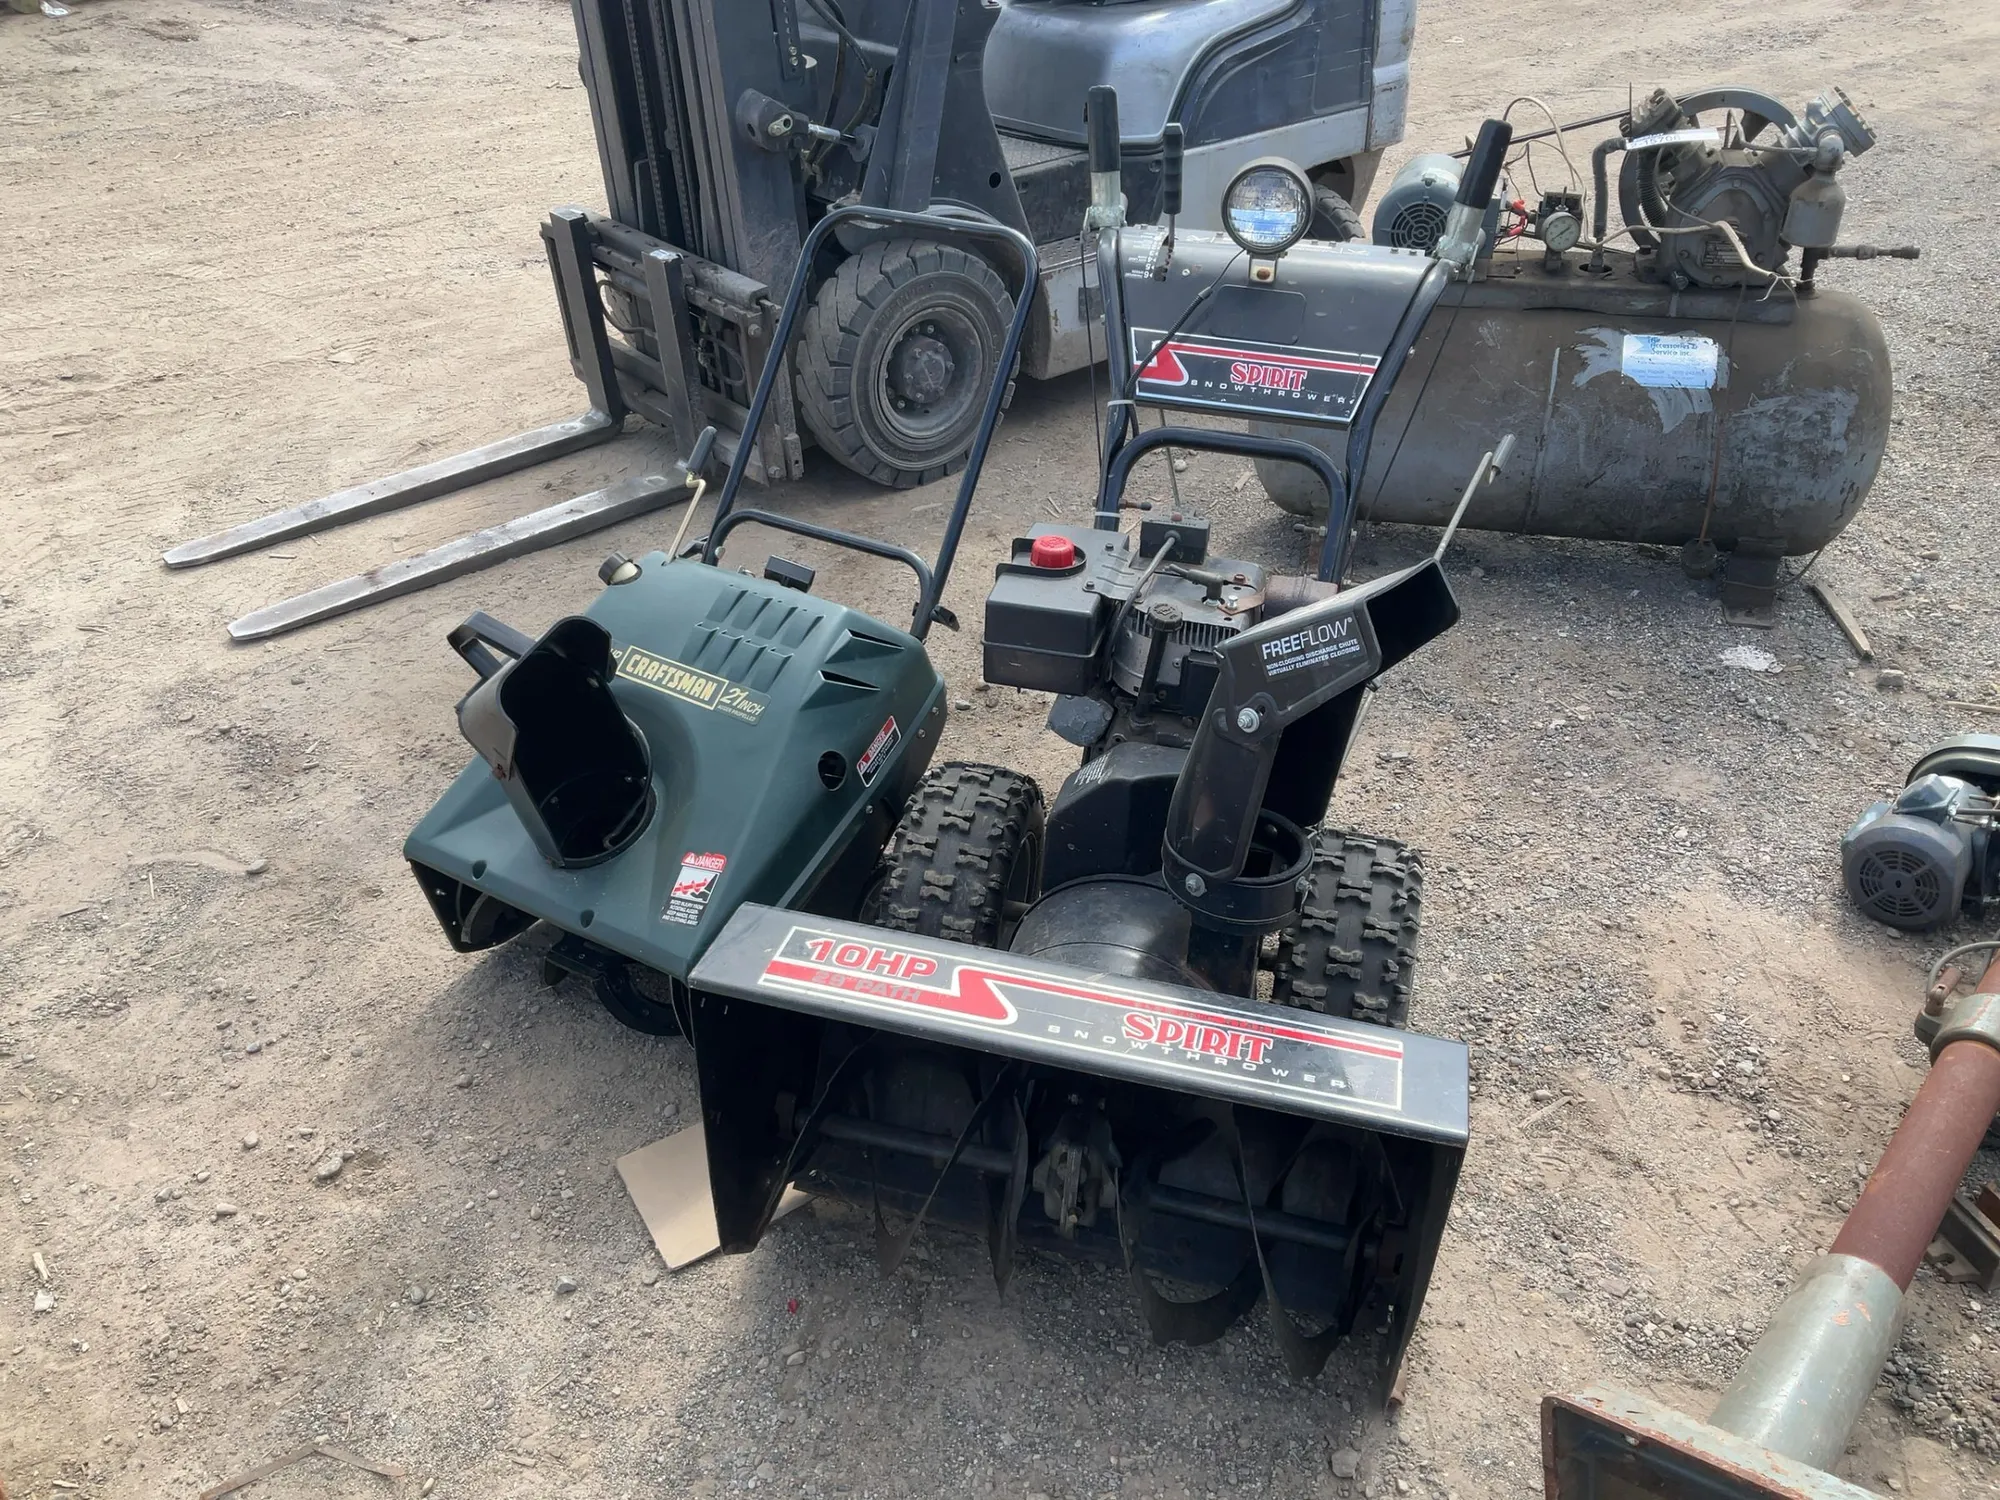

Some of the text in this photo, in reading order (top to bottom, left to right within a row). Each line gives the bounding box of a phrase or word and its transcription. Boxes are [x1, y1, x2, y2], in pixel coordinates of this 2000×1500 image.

[1190, 379, 1345, 405] SNOWTHROWER
[1230, 362, 1307, 391] SPIRIT
[1266, 638, 1358, 669] NON-CLOGGING DISCHARGE CHUTE
[1268, 644, 1360, 676] VIRTUALLY ELIMINATES CLOGGING
[626, 653, 718, 701] CRAFTSMAN
[805, 937, 938, 980] 10HP
[855, 978, 921, 1002] PATH
[1122, 1011, 1273, 1065] SPIRIT
[1047, 1024, 1347, 1089] SNOWTHROWER
